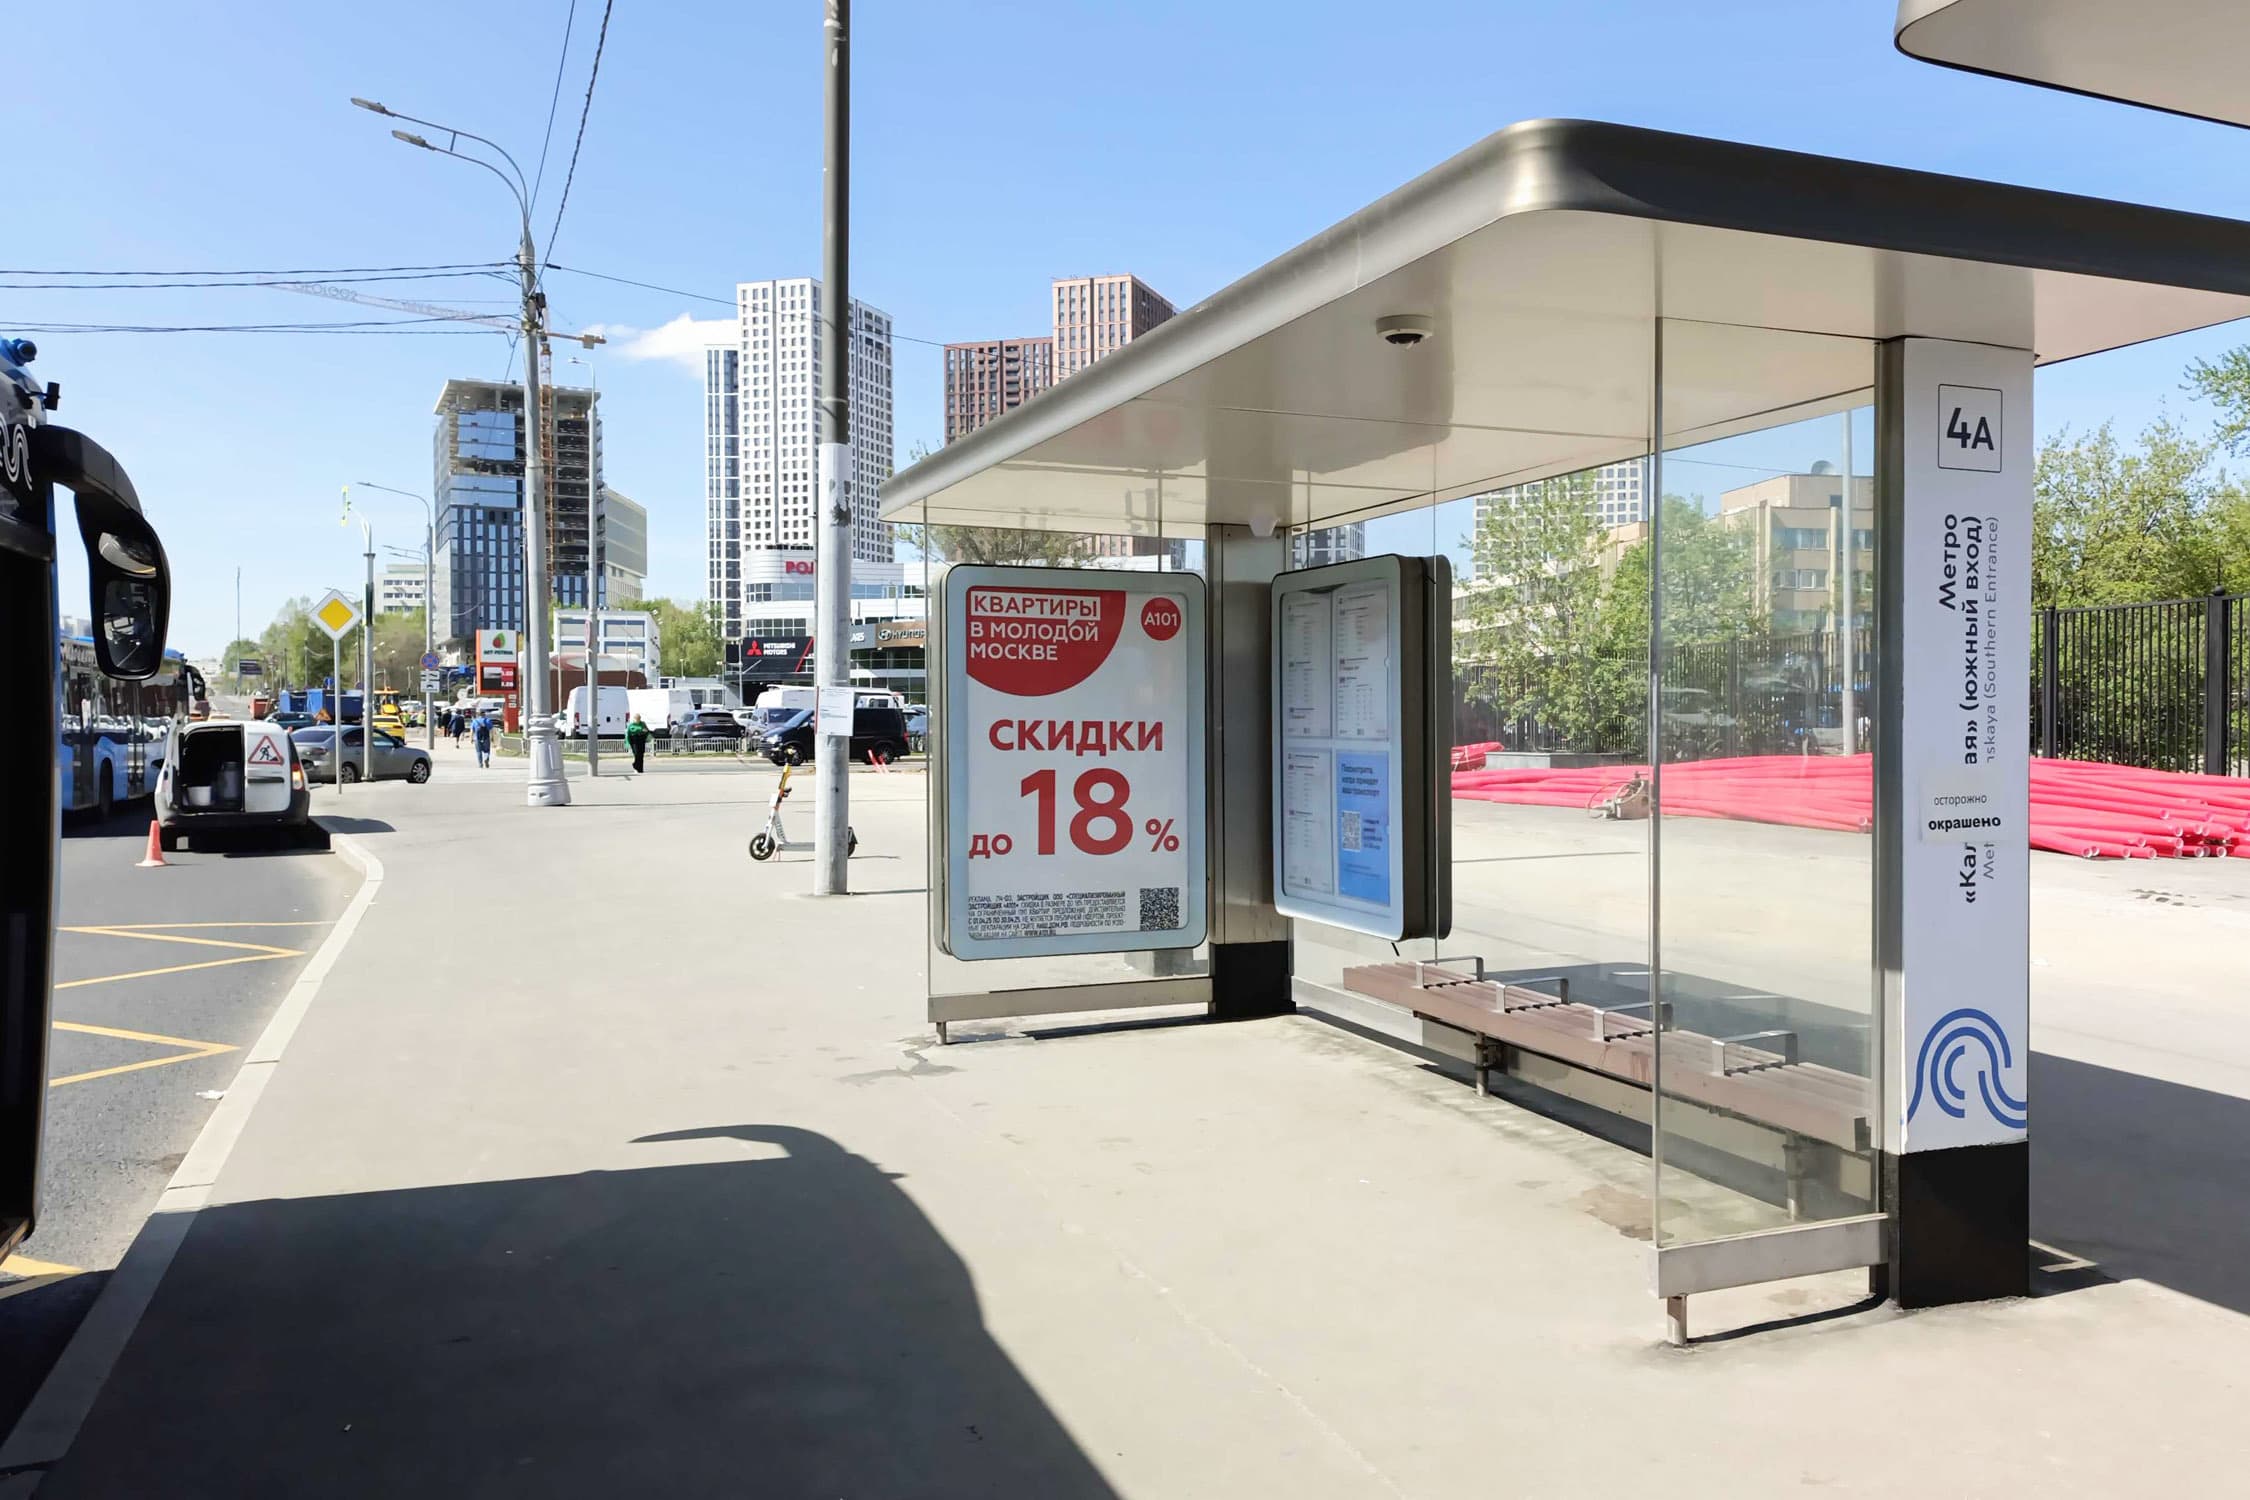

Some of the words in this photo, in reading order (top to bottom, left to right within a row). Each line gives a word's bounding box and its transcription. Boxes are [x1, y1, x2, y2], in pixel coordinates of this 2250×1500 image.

[1938, 513, 1961, 611] Метро
[1960, 516, 1983, 590] вход)
[1984, 516, 2000, 603] Entrance)
[973, 594, 1098, 618] КВАРТИРЫ
[970, 620, 984, 638] В
[990, 620, 1099, 643] МОЛОДОЙ
[970, 642, 1058, 661] МОСКВЕ
[1958, 599, 1980, 711] (южный
[1983, 608, 1998, 699] (Southern
[988, 718, 1163, 757] СКИДКИ
[1933, 794, 1988, 807] осторожно
[1927, 816, 2002, 833] окрашено
